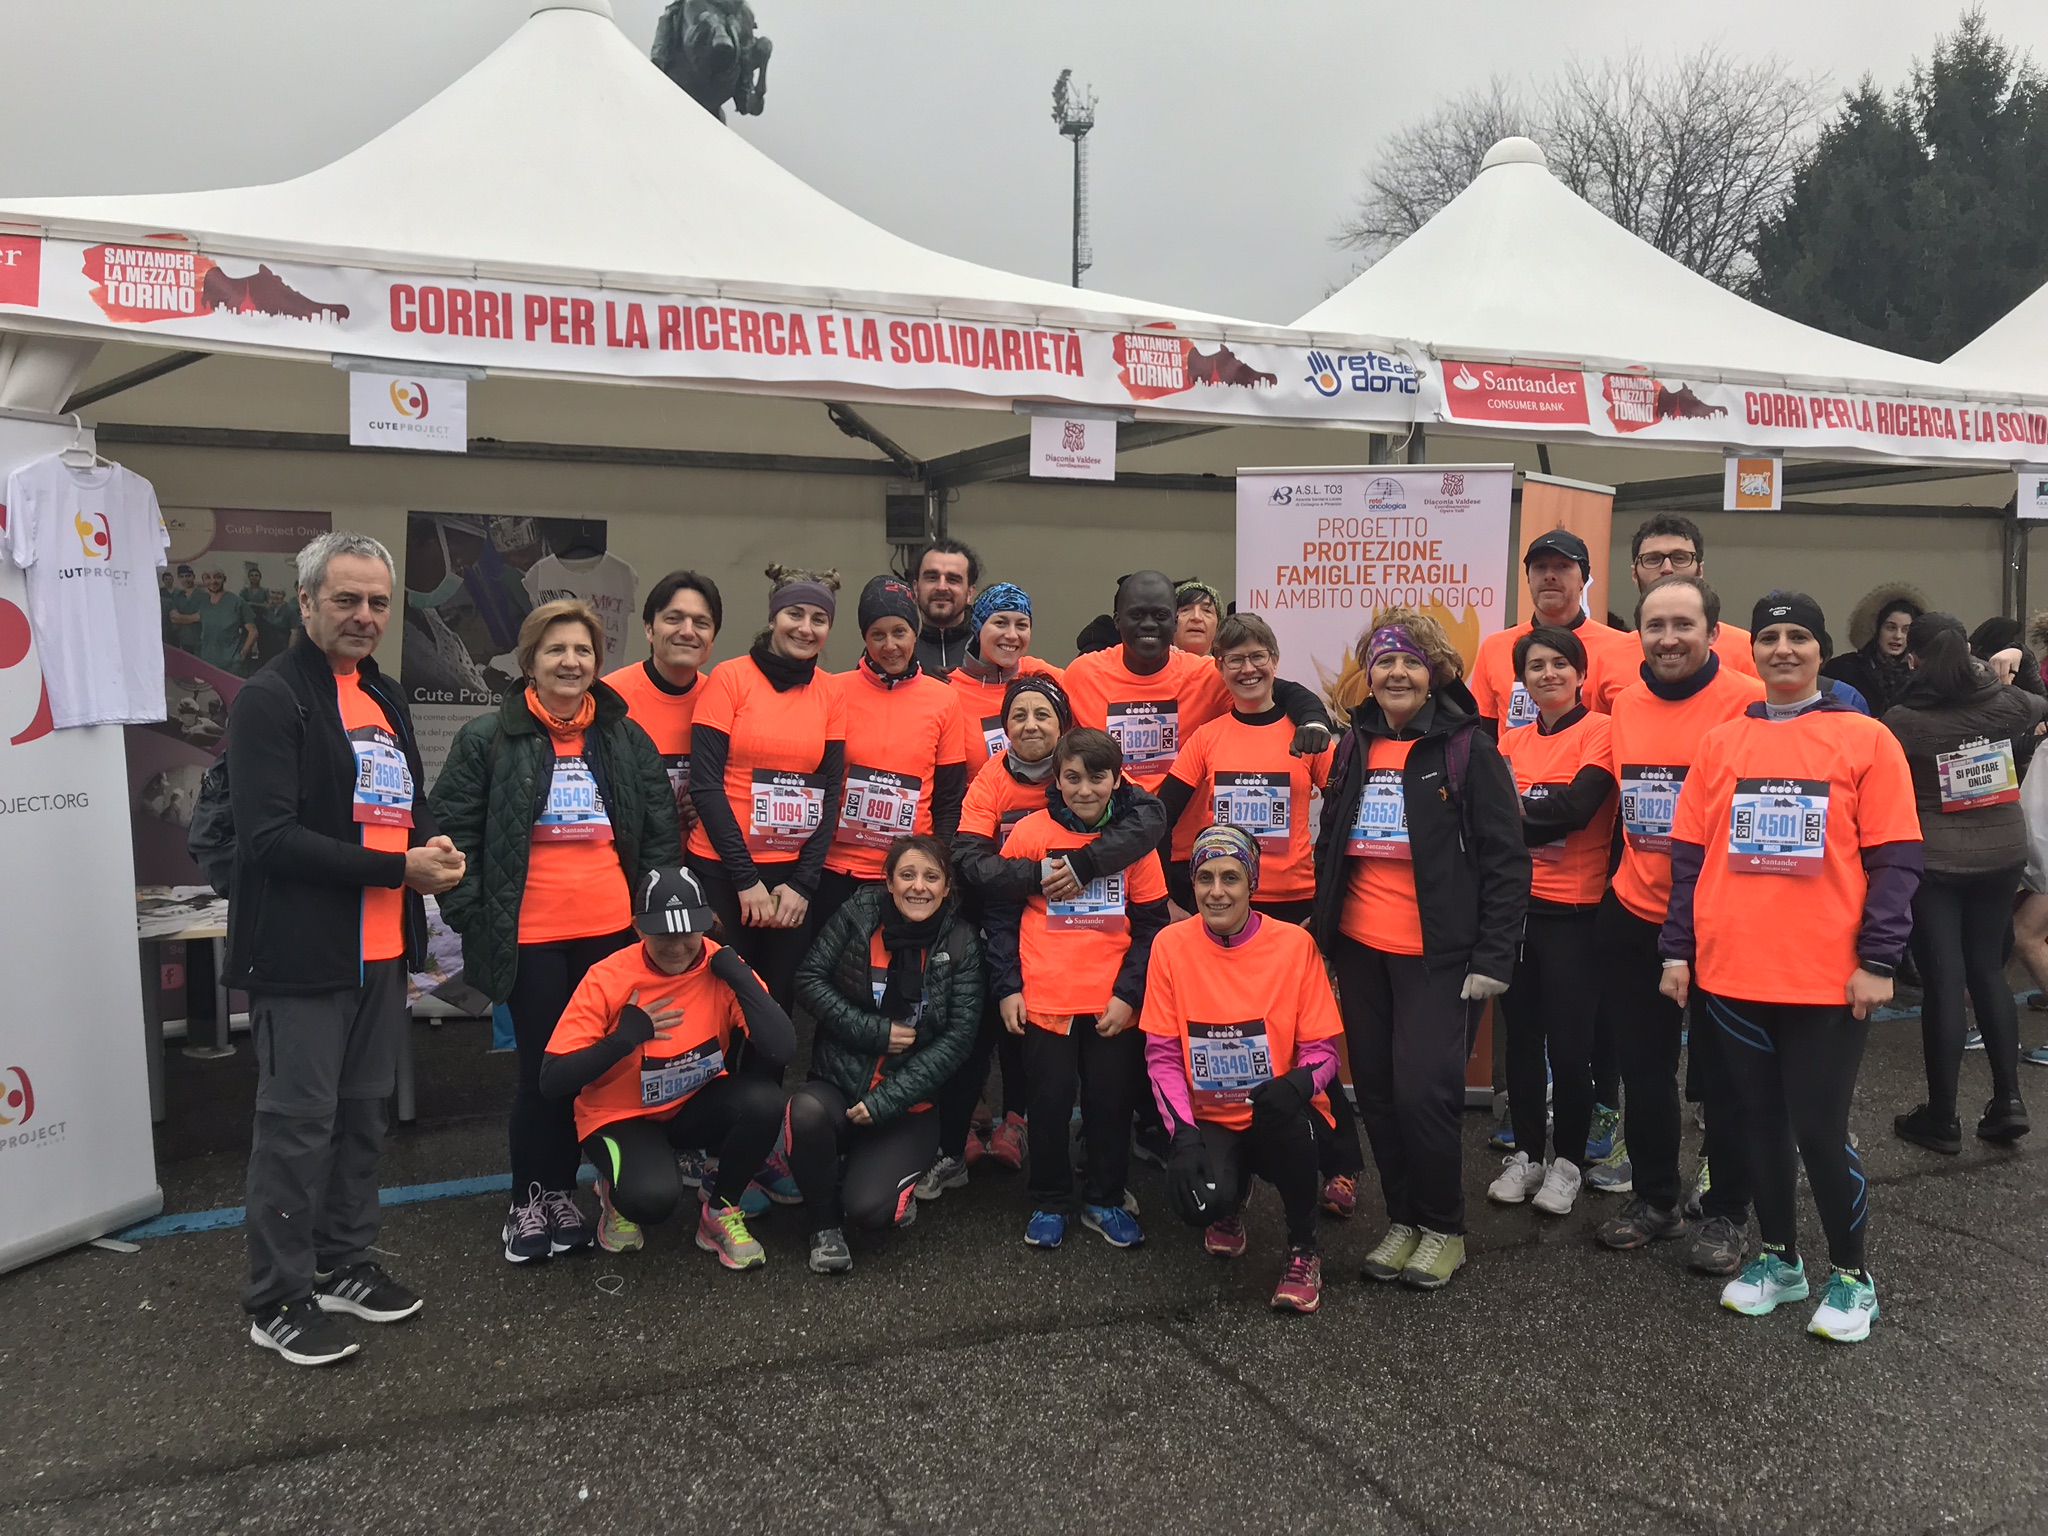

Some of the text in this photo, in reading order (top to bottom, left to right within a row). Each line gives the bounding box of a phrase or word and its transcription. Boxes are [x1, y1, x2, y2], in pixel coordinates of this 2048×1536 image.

[104, 247, 194, 271] SANTANDER
[104, 265, 195, 287] LA MEZZA DI
[105, 281, 195, 313] TORINO
[390, 283, 1085, 377] CORRI PER LA RICERCA E LA SOLIDARIETÀ
[1124, 334, 1180, 353] SANTANDER
[1125, 349, 1182, 366] LA MEZZA DI
[1337, 351, 1393, 373] rete
[1126, 363, 1184, 389] TORINO
[1484, 370, 1577, 395] Santander
[1610, 375, 1654, 390] SANTANDER
[1487, 398, 1564, 412] CONSUMER BANK
[1613, 401, 1654, 423] TORINO
[1745, 391, 1808, 428] CORRI
[1810, 397, 1853, 429] PER
[1851, 399, 1875, 433] LA
[1876, 402, 1957, 440] RICERCA
[1958, 409, 1970, 441] E
[1974, 410, 1996, 442] LA
[1045, 453, 1102, 464] Diaconia Valdese
[1295, 484, 1343, 495] A.S.L. TO3
[1369, 503, 1407, 512] oncologica
[1424, 498, 1482, 506] Diaconia Valdese
[225, 524, 251, 535] Cute
[255, 525, 294, 537] Project
[1317, 516, 1428, 539] PROGETTO
[1303, 540, 1443, 562] PROTEZIONE
[1276, 563, 1468, 586] FAMIGLIE FRAGILI
[1249, 586, 1494, 610] IN AMBITO ONCOLOGICO
[414, 687, 454, 701] Cute
[1126, 730, 1158, 748] 3820
[375, 763, 401, 789] 3583
[1955, 770, 1965, 779] SI
[1965, 765, 1981, 777] PUÒ
[1981, 761, 1999, 774] FARE
[1968, 774, 1992, 788] ONLUS
[553, 787, 590, 808] 3543
[772, 802, 803, 822] 1094
[866, 799, 893, 820] 890
[1234, 802, 1267, 821] 3786
[1362, 801, 1398, 823] 3553
[1639, 798, 1671, 819] 3826
[1757, 813, 1797, 837] 4501
[1365, 842, 1396, 851] Santander
[1761, 857, 1797, 866] Santander
